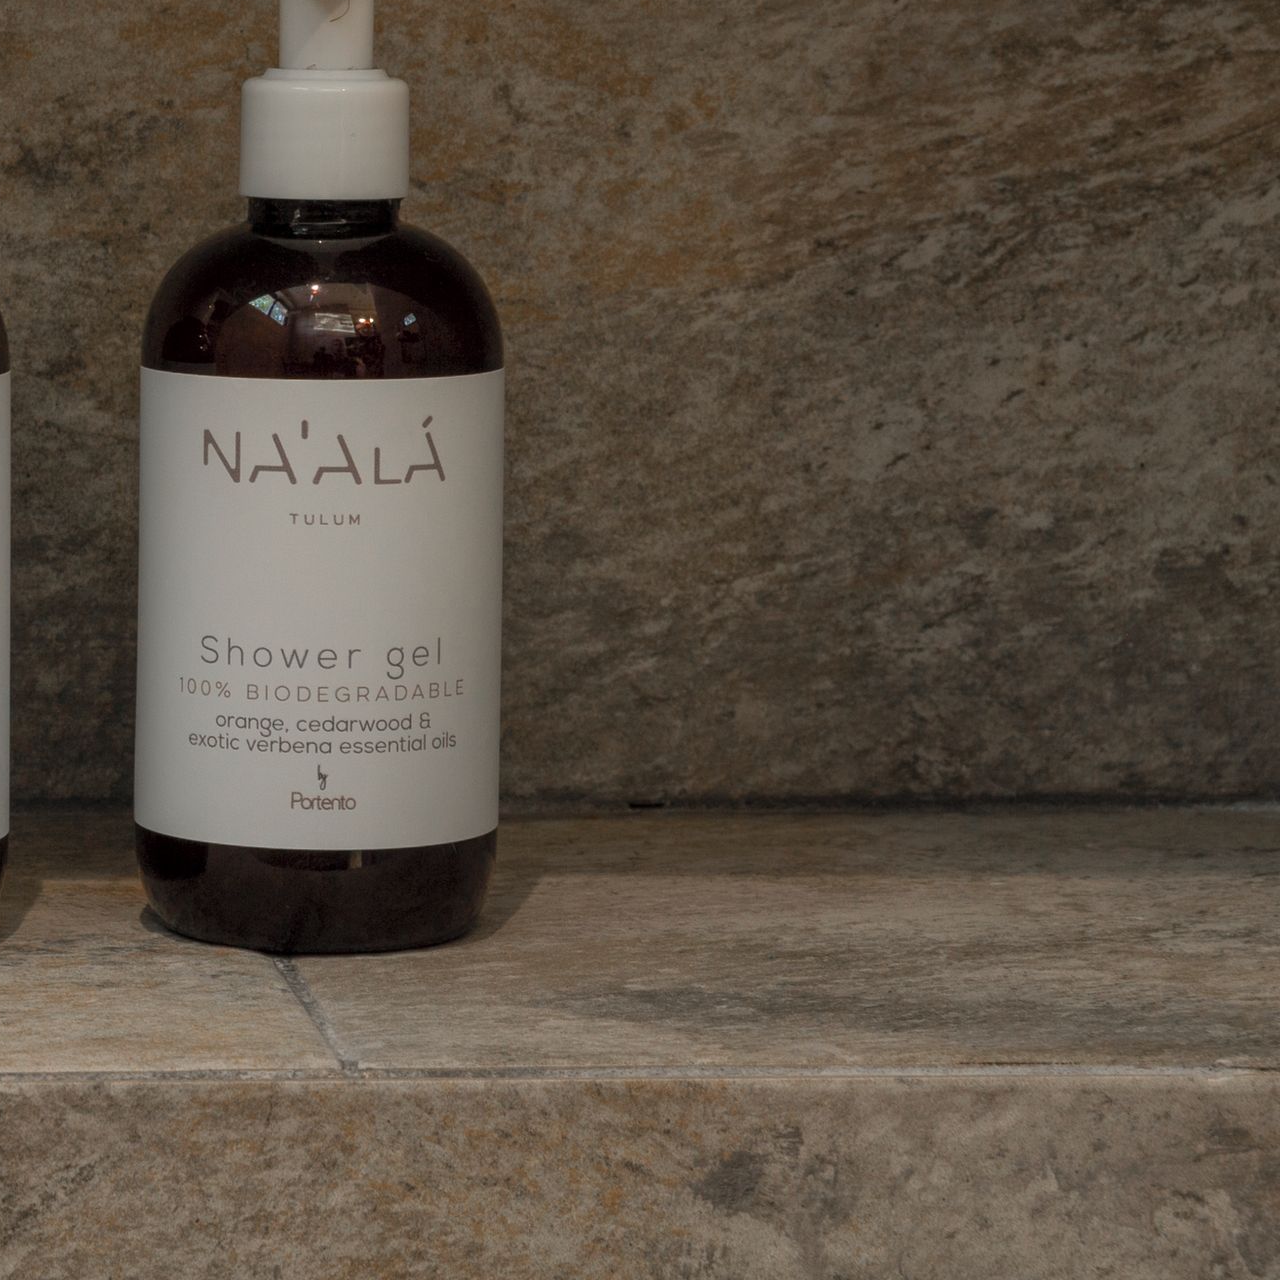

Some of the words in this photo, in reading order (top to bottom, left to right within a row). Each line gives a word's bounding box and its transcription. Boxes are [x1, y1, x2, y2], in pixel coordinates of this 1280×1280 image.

[289, 513, 362, 526] TULUM
[200, 634, 362, 670] Shower
[386, 636, 442, 680] gel
[179, 676, 231, 699] 100%
[246, 678, 465, 703] BIODEGRADABLE
[215, 713, 289, 737] orange,
[296, 713, 413, 733] cedarwood
[419, 712, 431, 729] &
[188, 731, 240, 751] exotic
[246, 734, 332, 754] verbena
[339, 733, 427, 754] essential
[431, 731, 456, 750] oils
[317, 764, 328, 790] by
[290, 792, 356, 811] Portento
